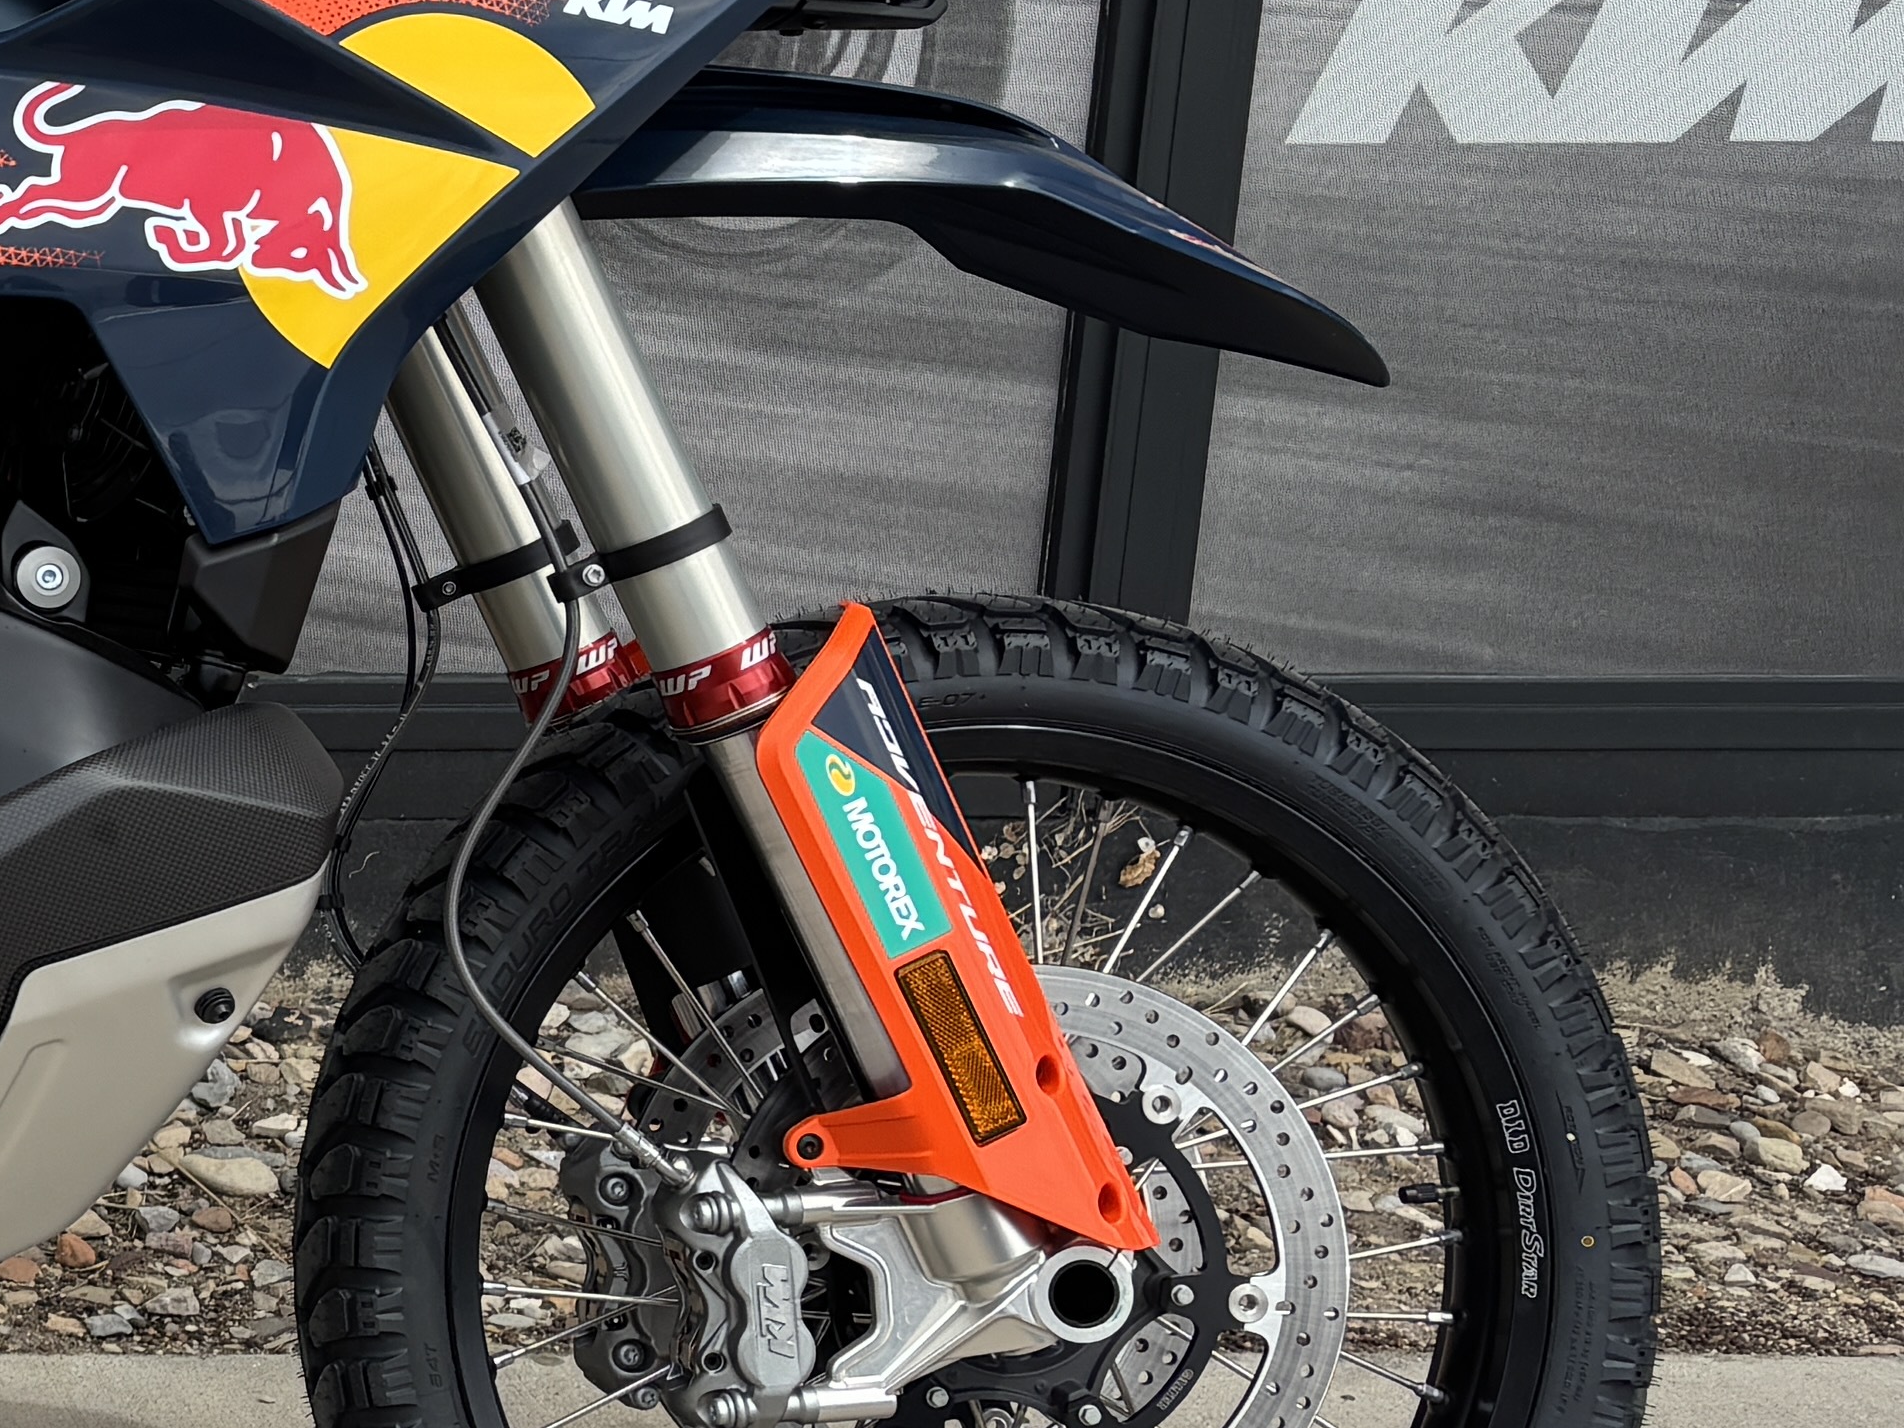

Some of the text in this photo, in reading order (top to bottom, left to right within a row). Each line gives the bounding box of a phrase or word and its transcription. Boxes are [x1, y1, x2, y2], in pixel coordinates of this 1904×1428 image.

[659, 664, 712, 697] WP
[843, 796, 925, 941] MOTOREX
[856, 677, 1024, 1017] ADVENTURE
[1496, 1099, 1530, 1154] DID
[755, 1263, 796, 1360] KTM
